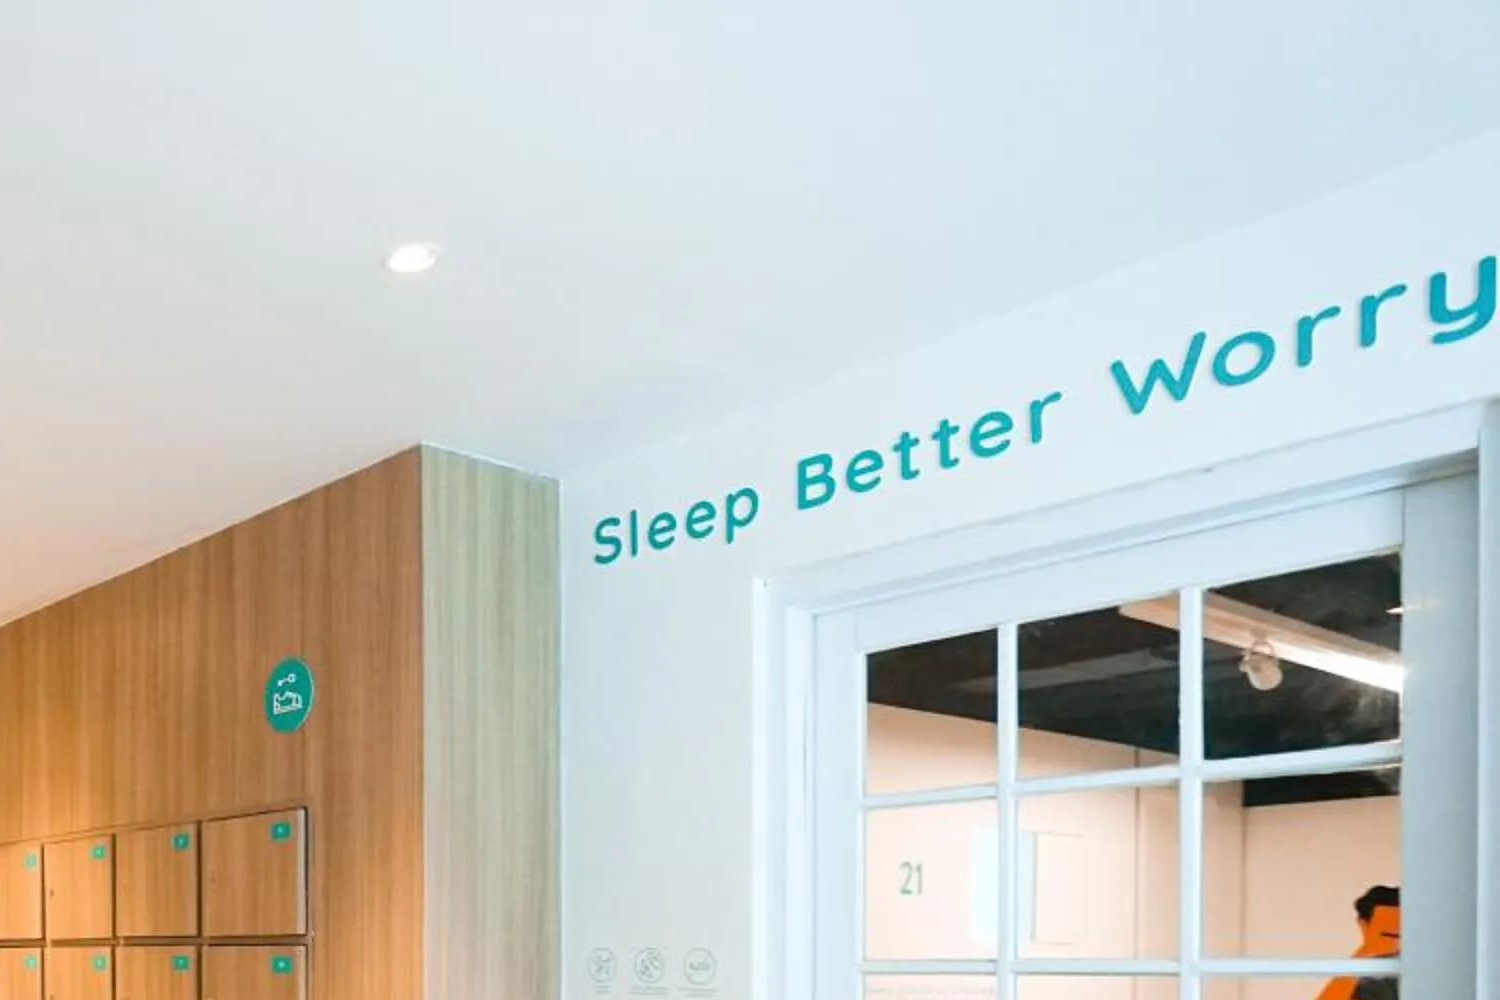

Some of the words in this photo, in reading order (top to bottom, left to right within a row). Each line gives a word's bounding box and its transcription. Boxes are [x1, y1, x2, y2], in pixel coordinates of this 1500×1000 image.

[594, 486, 761, 566] Sleep
[796, 390, 1062, 511] Better
[1109, 255, 1498, 416] Worry
[899, 861, 923, 896] 21
